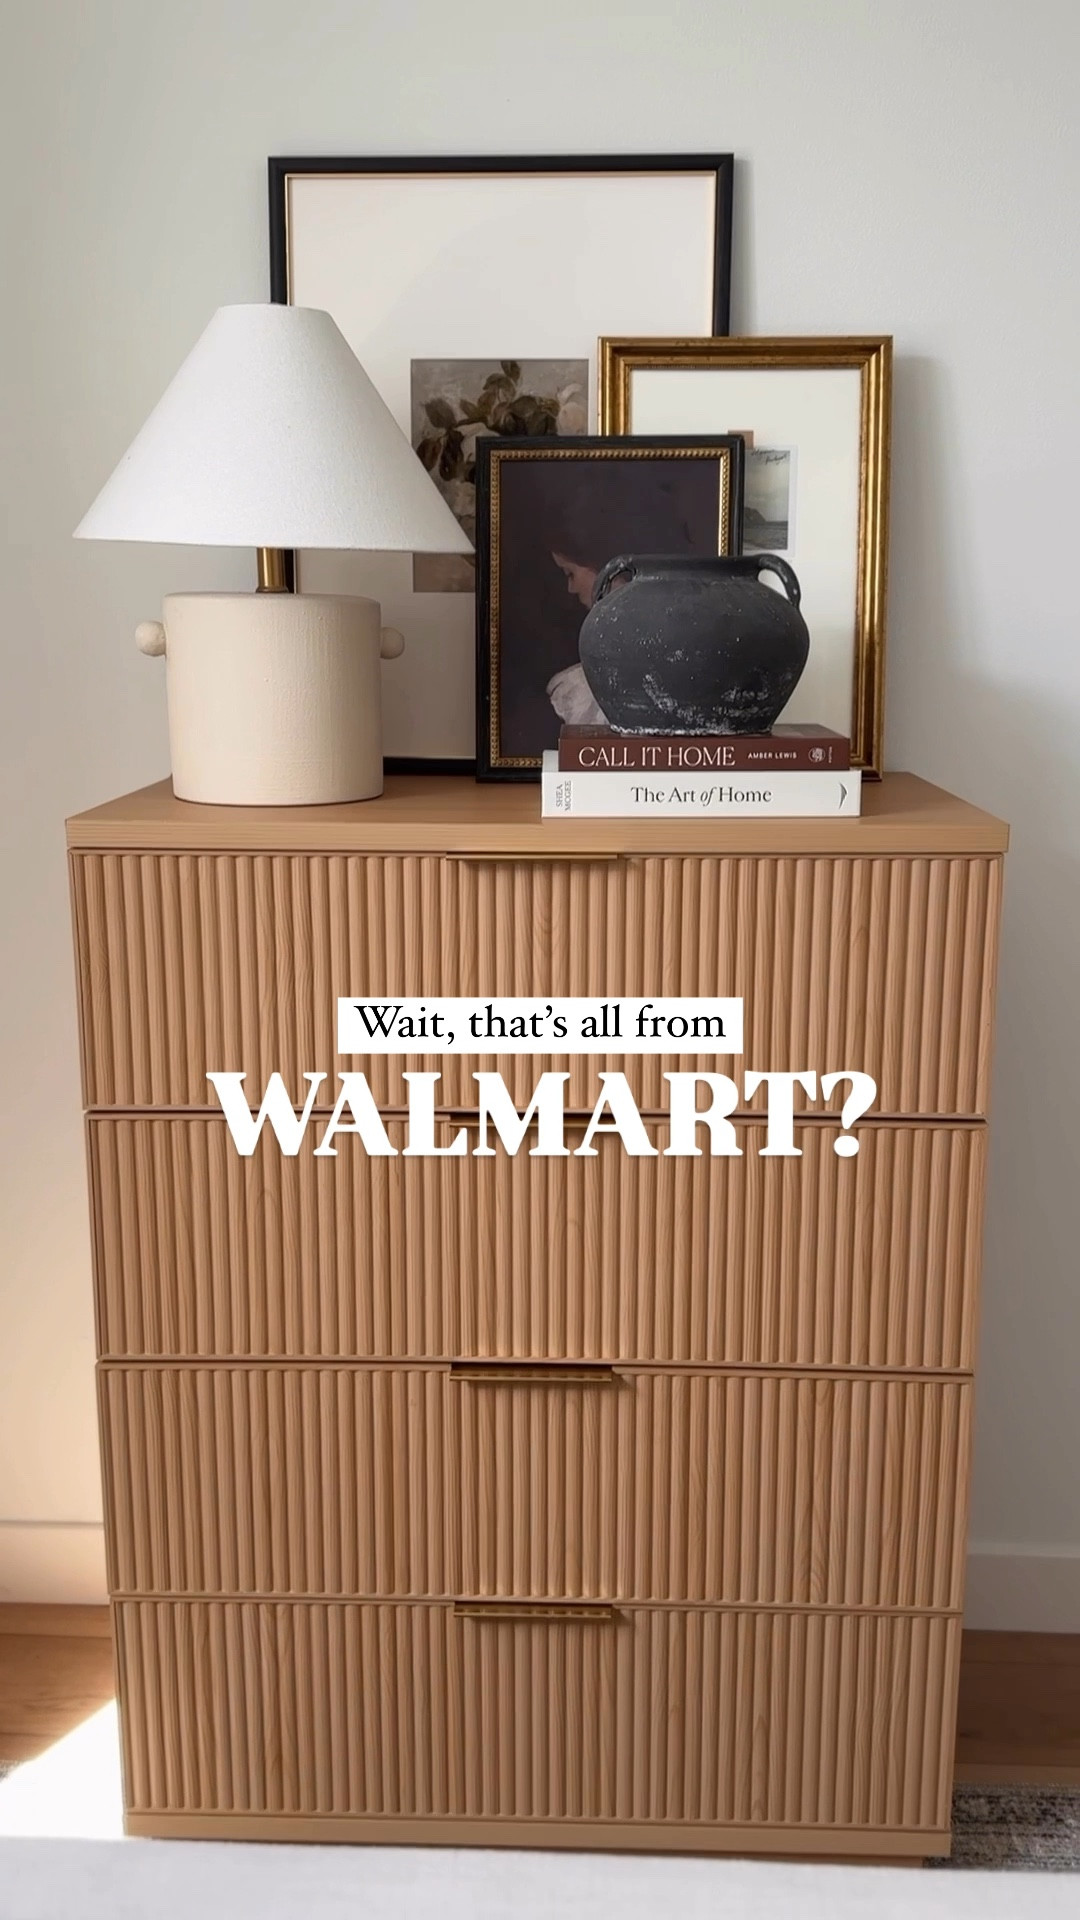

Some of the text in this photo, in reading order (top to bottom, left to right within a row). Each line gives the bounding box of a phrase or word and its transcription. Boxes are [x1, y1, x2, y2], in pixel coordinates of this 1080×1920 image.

[578, 746, 736, 767] CALL IT HOME
[747, 752, 798, 760] AMBER LEWIS
[630, 786, 772, 807] The Art of Home
